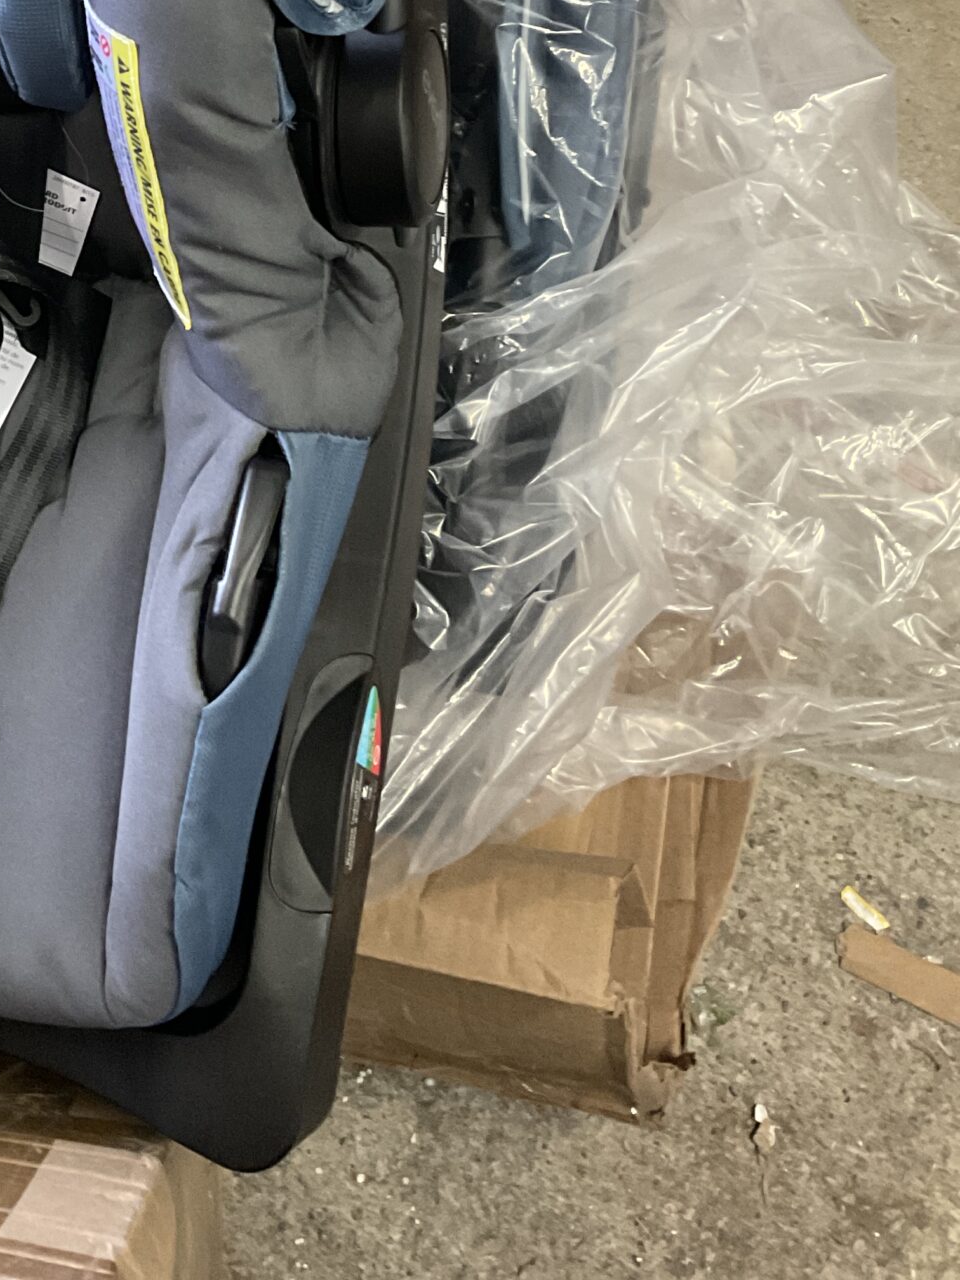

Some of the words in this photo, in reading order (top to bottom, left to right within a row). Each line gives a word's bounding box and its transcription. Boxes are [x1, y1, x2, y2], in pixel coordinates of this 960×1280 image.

[121, 82, 147, 170] WARNING
[140, 176, 157, 223] MISE
[150, 222, 164, 248] EN
